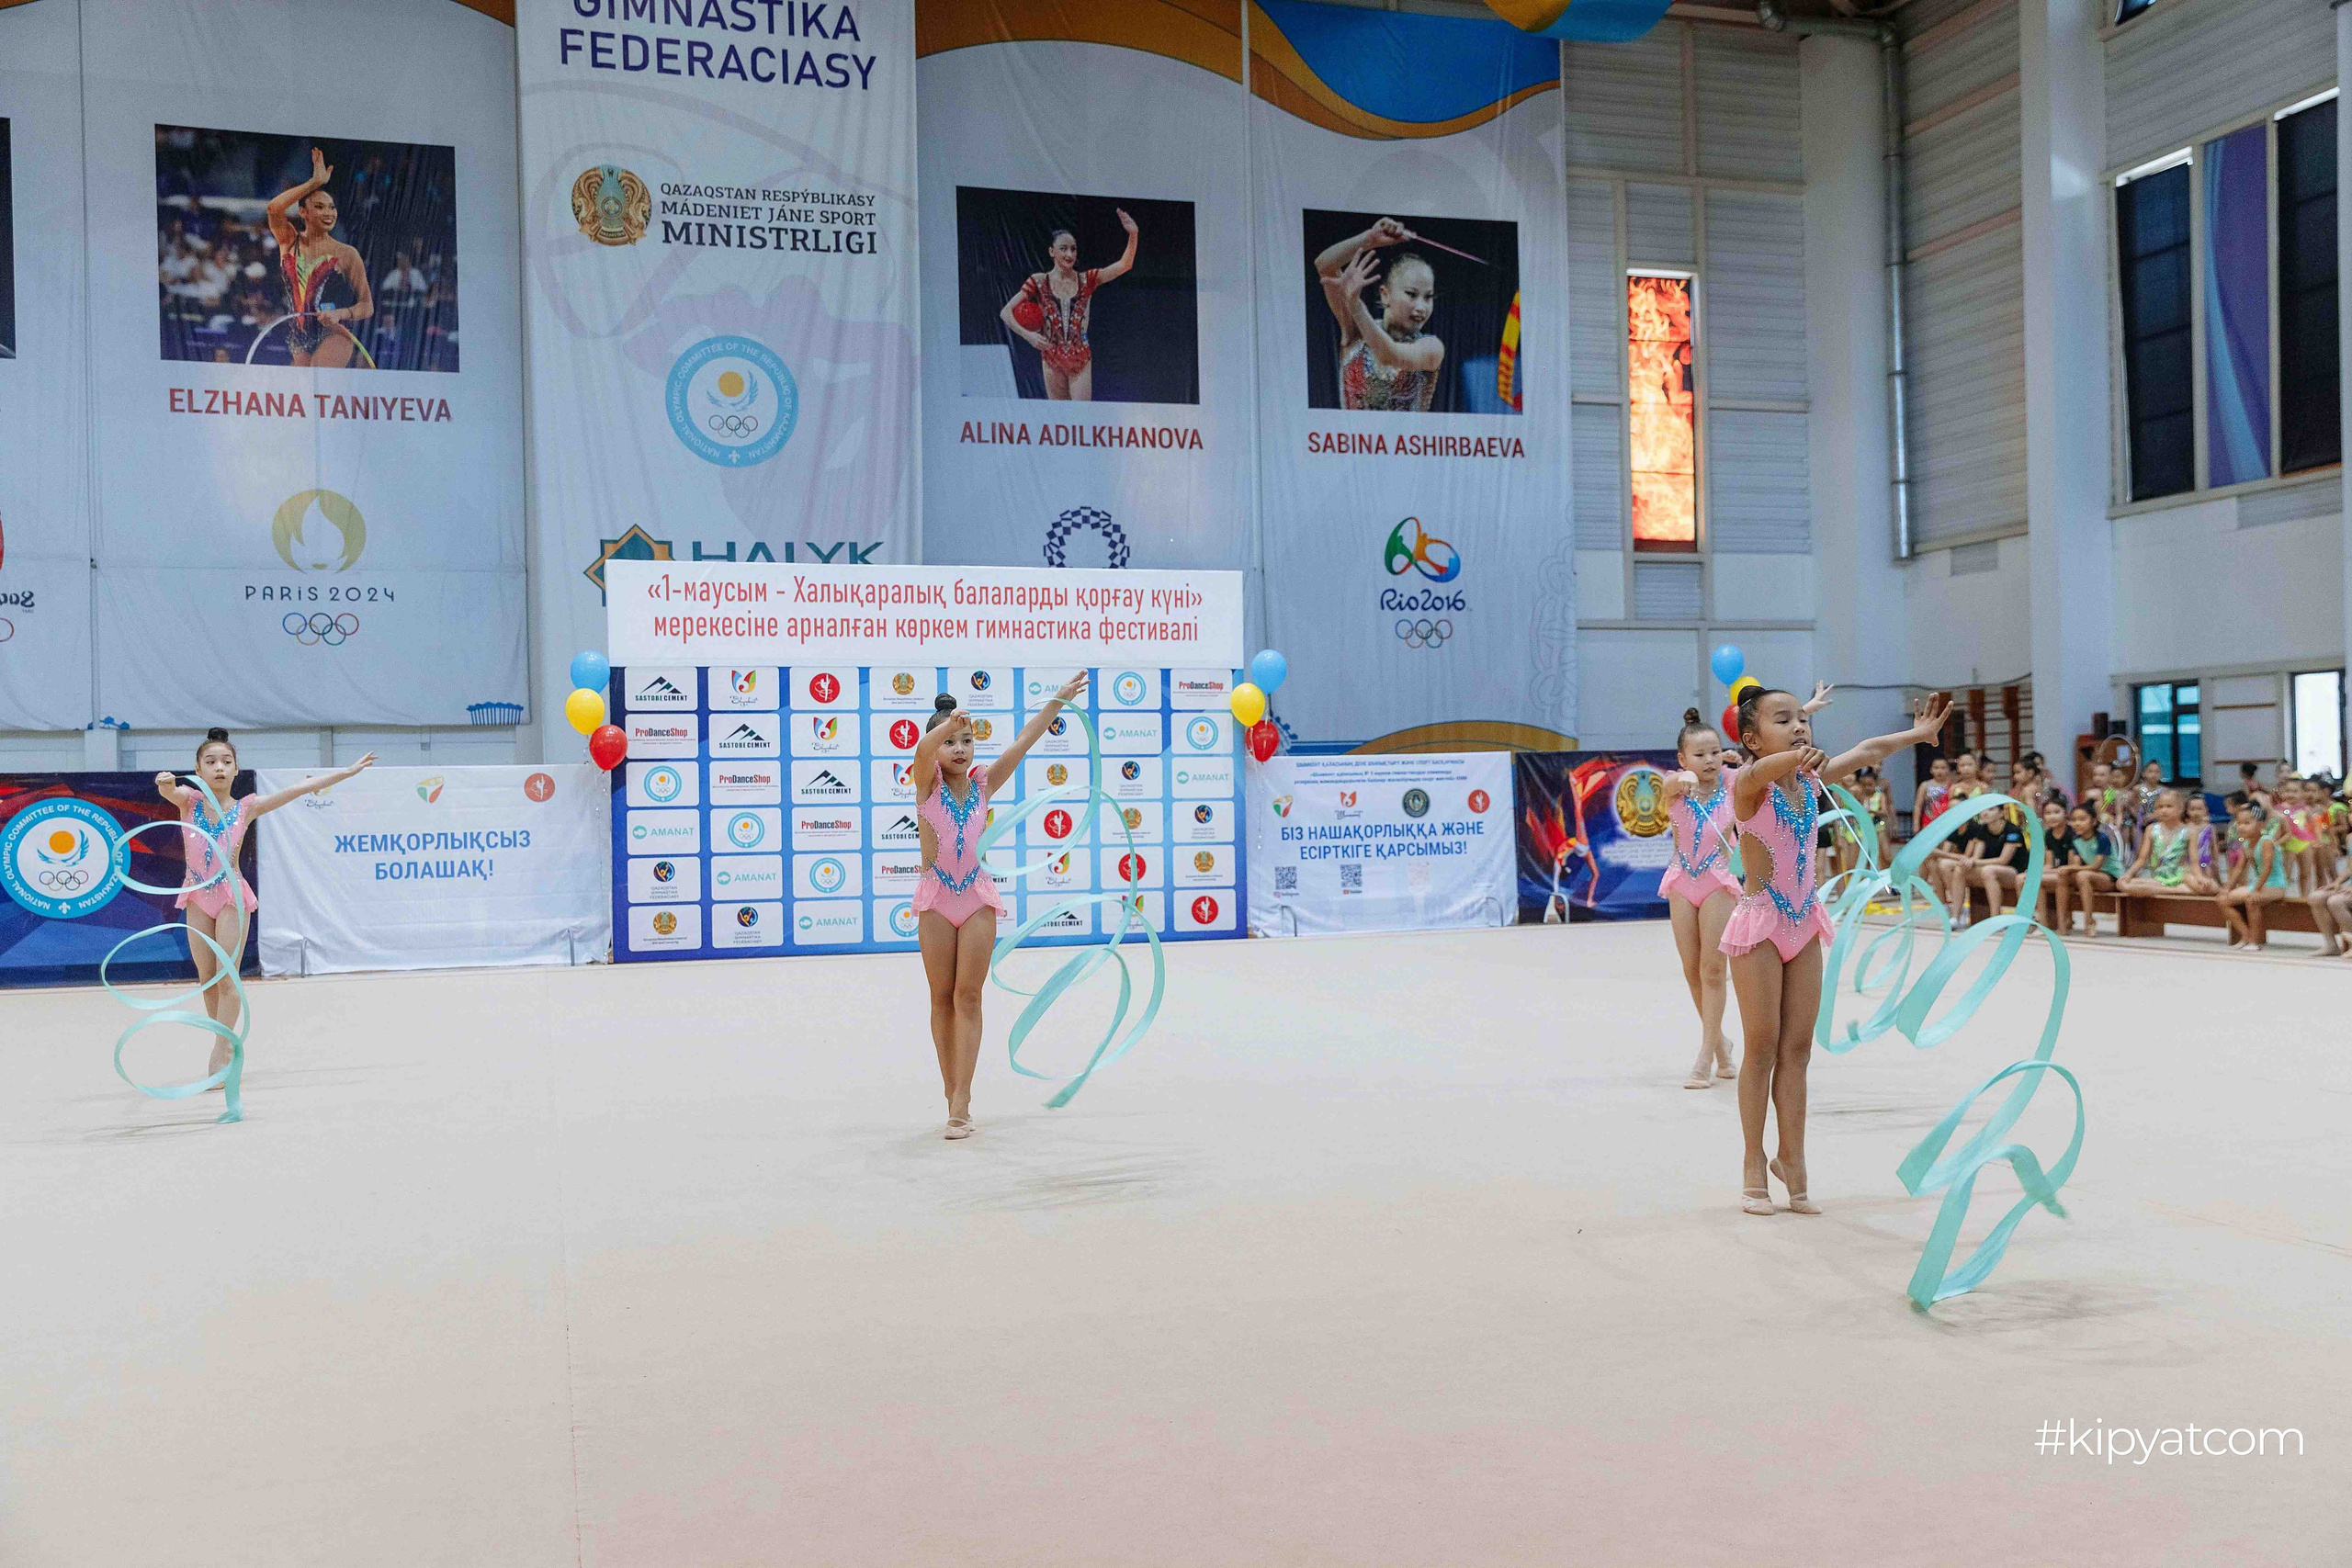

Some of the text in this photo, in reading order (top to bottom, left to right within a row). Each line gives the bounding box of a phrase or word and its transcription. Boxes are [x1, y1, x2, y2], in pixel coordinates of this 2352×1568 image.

[560, 28, 876, 90] FEDERACIASY
[661, 183, 876, 207] QAZAQSTAN RESPÝBLIKASY
[661, 199, 876, 226] MÁDENIET JÁNE SPORT
[662, 220, 877, 254] MINISTRLIGI
[677, 343, 723, 379] COMMITTEE
[741, 344, 759, 356] THE
[169, 388, 453, 423] ELZHANA TANIYEVA
[960, 422, 1204, 450] ALINA ADILKHANOVA
[1308, 432, 1525, 458] SABINA ASHIRBAEVA
[0, 591, 35, 607] 008
[329, 586, 395, 602] 2024
[648, 573, 767, 609] «1-маусым
[794, 575, 947, 611] Халықаралық
[954, 579, 1069, 613] балаларды
[1076, 585, 1145, 615] қорғау
[1151, 583, 1204, 615] күні»
[654, 610, 1199, 645] мерекесіне арналған көркем гимнастика фестивалі
[635, 728, 687, 739] ProDanceShop
[1119, 729, 1158, 738] AMANAT
[719, 775, 771, 784] ProDanceShop
[8, 806, 54, 840] COMMITTEE
[73, 806, 91, 817] THE
[91, 813, 119, 842] REPUBL
[650, 828, 695, 837] AMANAT
[801, 820, 852, 829] ProDanceShop
[1281, 821, 1484, 842] БІЗ НАШАҚОРЛЫҚҚА ЖӘНЕ
[334, 830, 531, 855] ЖЕМҚОРЛЫҚСЫЗ
[1300, 841, 1468, 861] ЕСІРТКІГЕ ҚАРСЫМЫЗ!
[3, 841, 15, 880] OLYMPIC
[375, 859, 494, 881] БОЛАШАҚ!
[881, 866, 920, 874] ProDanceS
[734, 874, 777, 882] AMANAT
[12, 881, 51, 910] NATIONAL
[816, 918, 858, 926] AMANAT
